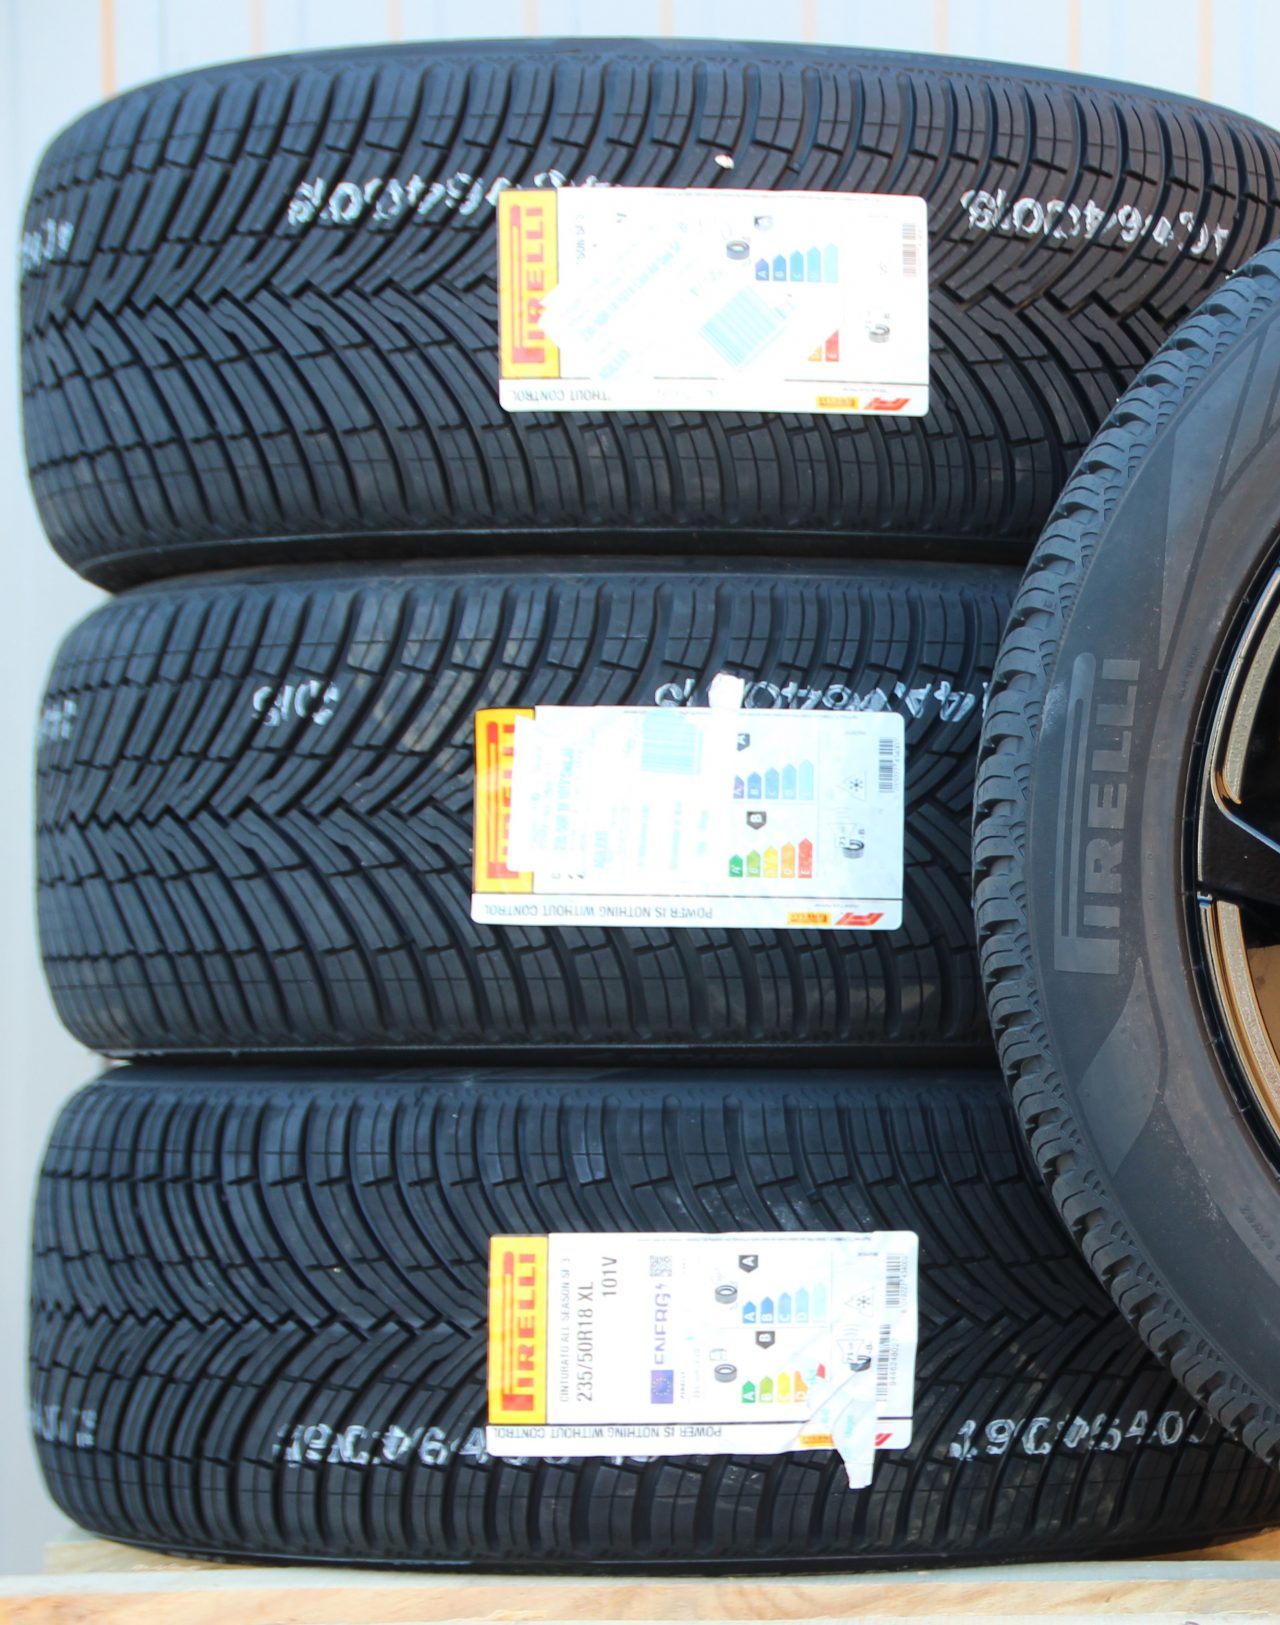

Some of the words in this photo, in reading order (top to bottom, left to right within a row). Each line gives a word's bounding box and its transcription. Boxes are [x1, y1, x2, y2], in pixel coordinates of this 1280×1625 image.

[510, 204, 547, 364] PIRELLI
[512, 388, 566, 402] CONTROL
[570, 388, 613, 402] THOUT
[1053, 651, 1141, 976] PIRELLI
[485, 904, 538, 917] CONTROL
[542, 905, 595, 917] WITHOUT
[599, 905, 651, 918] NOTHING
[655, 905, 667, 918] IS
[669, 906, 713, 919] POWER
[601, 1256, 618, 1297] 101V
[577, 1281, 594, 1302] XL
[560, 1281, 570, 1322] SEASON
[501, 1251, 536, 1411] PIRELLI
[576, 1307, 594, 1403] 235/50R18
[493, 1427, 545, 1439] CONTROL
[551, 1427, 604, 1439] WITHOUT
[607, 1427, 660, 1438] NOTHING
[664, 1426, 676, 1438] IS
[679, 1426, 722, 1438] POWER
